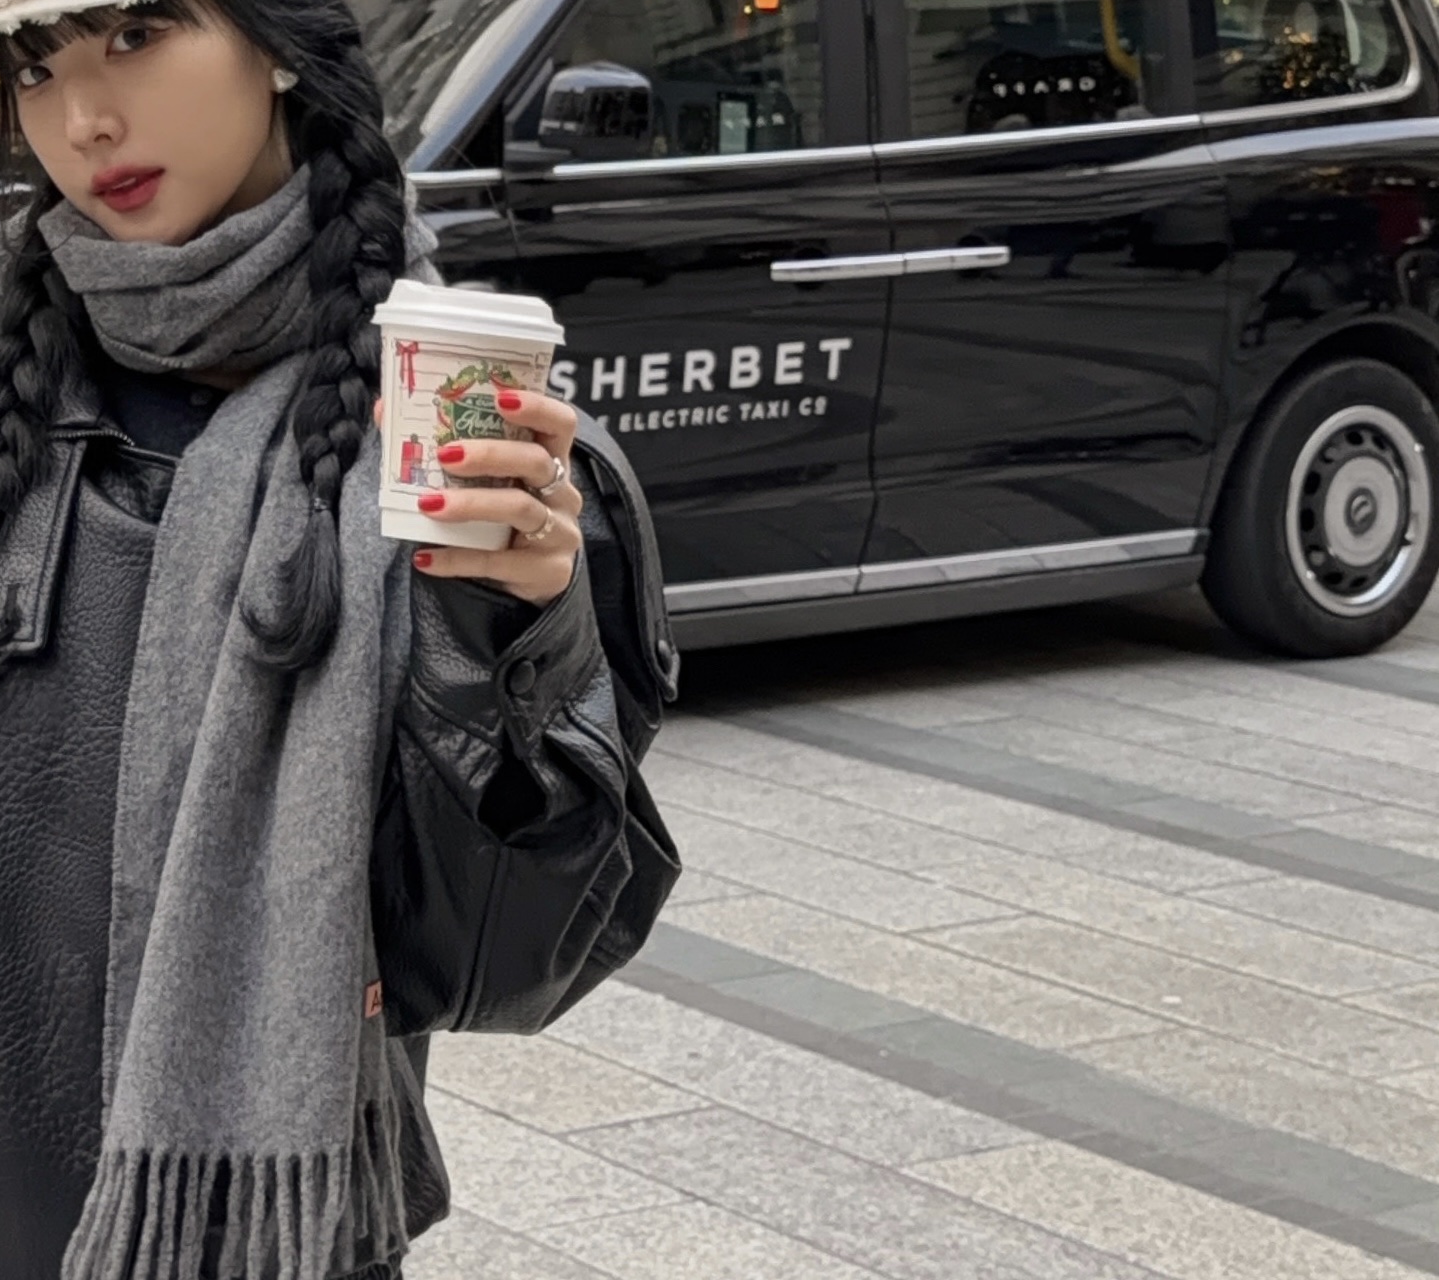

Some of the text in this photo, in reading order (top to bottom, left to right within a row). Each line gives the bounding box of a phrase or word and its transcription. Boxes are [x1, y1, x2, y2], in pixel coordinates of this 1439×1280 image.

[549, 337, 853, 403] SHERBET
[619, 404, 731, 433] ELECTRIC
[739, 400, 790, 422] TAXI
